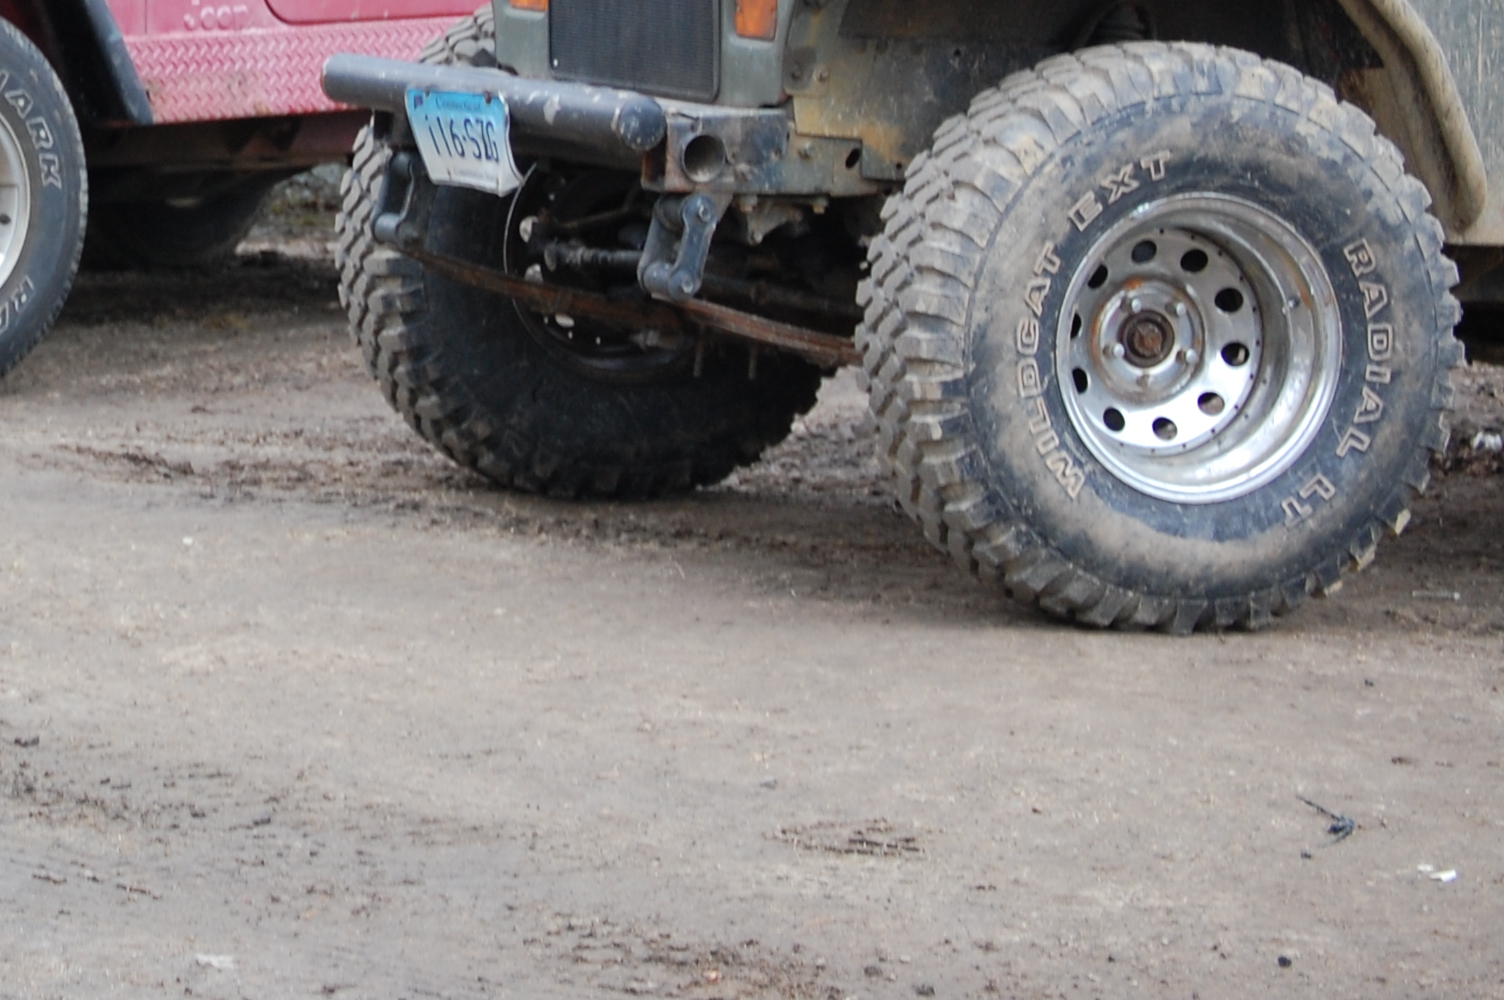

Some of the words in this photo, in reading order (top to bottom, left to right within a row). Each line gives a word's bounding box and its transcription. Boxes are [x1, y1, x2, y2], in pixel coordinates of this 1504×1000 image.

[1015, 241, 1091, 499] WILDCAT
[1068, 151, 1171, 232] EXT
[1337, 237, 1394, 460] RADIAL
[1280, 472, 1336, 530] LT
